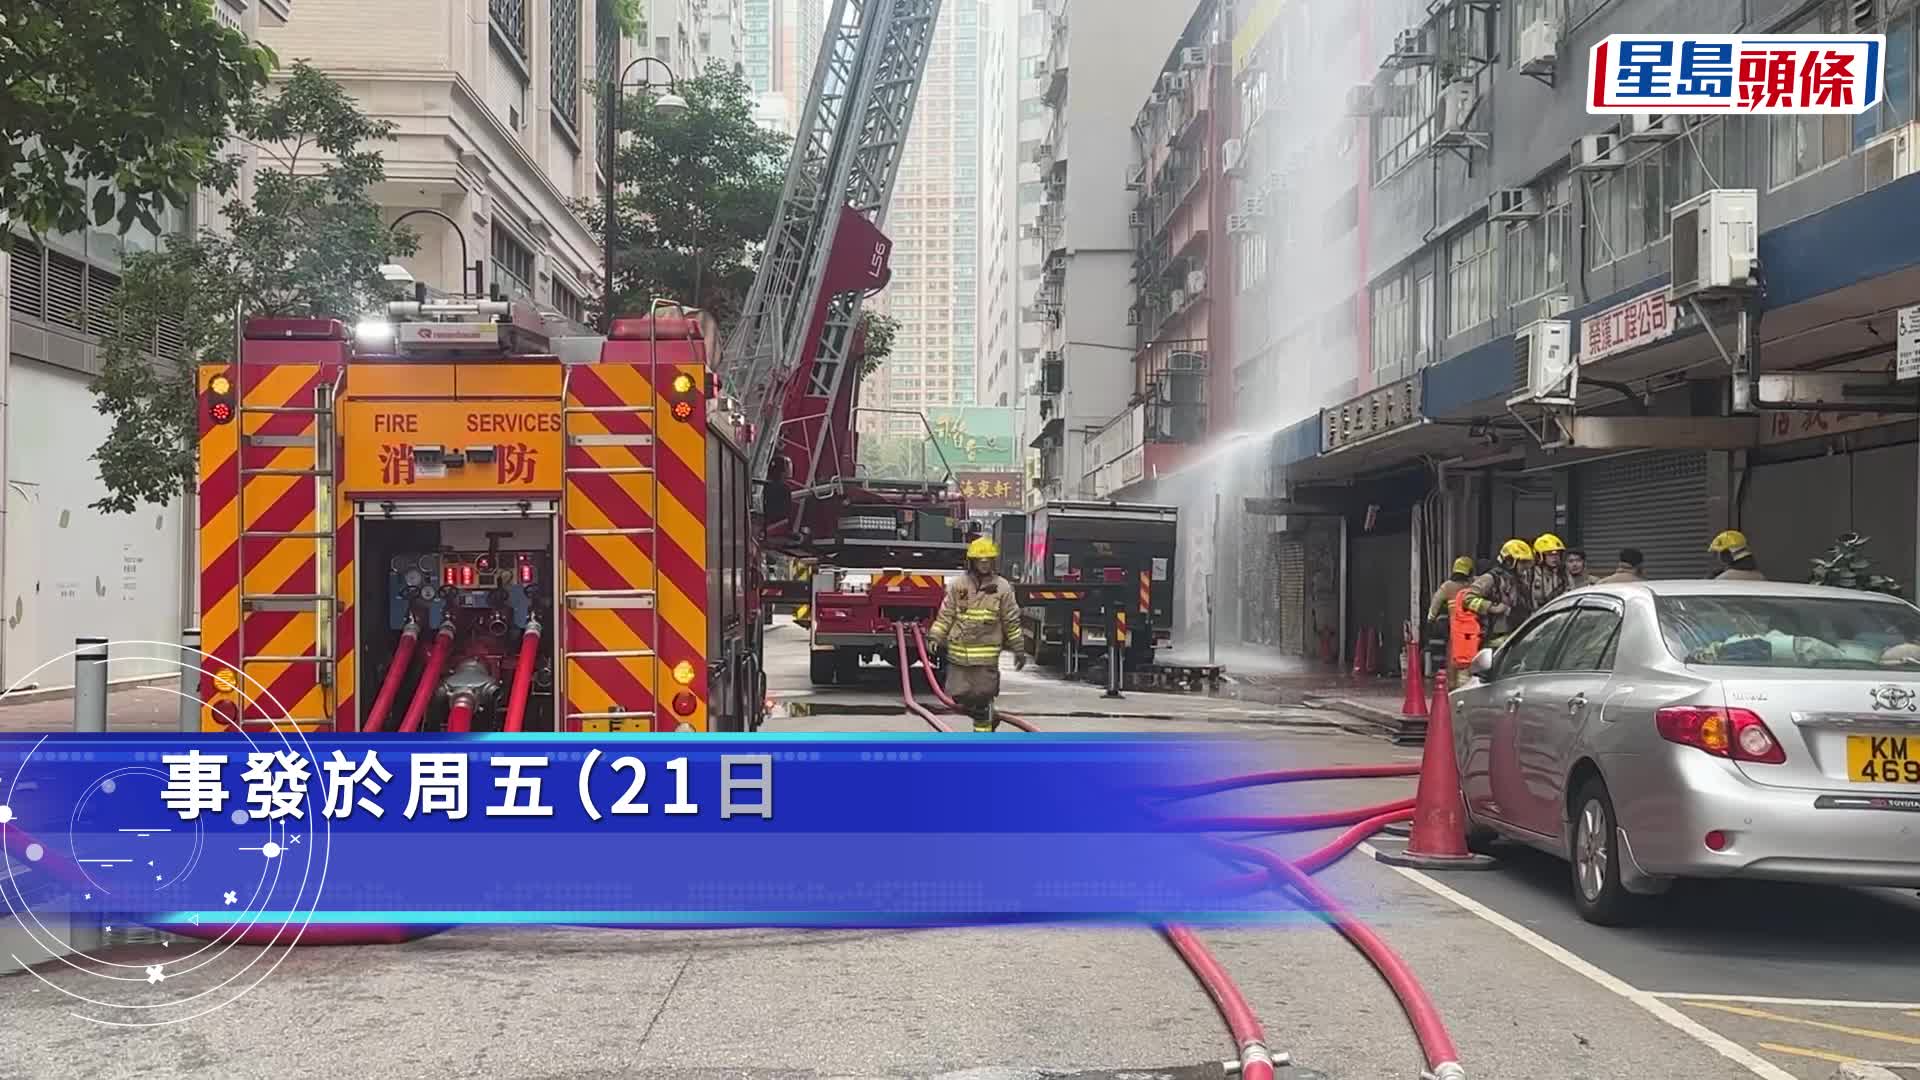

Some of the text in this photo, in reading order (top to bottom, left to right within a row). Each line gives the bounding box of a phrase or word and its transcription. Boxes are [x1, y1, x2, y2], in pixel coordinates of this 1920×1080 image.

[868, 241, 886, 277] L56
[375, 413, 561, 432] FIRE SERVICES
[1871, 736, 1907, 760] KM
